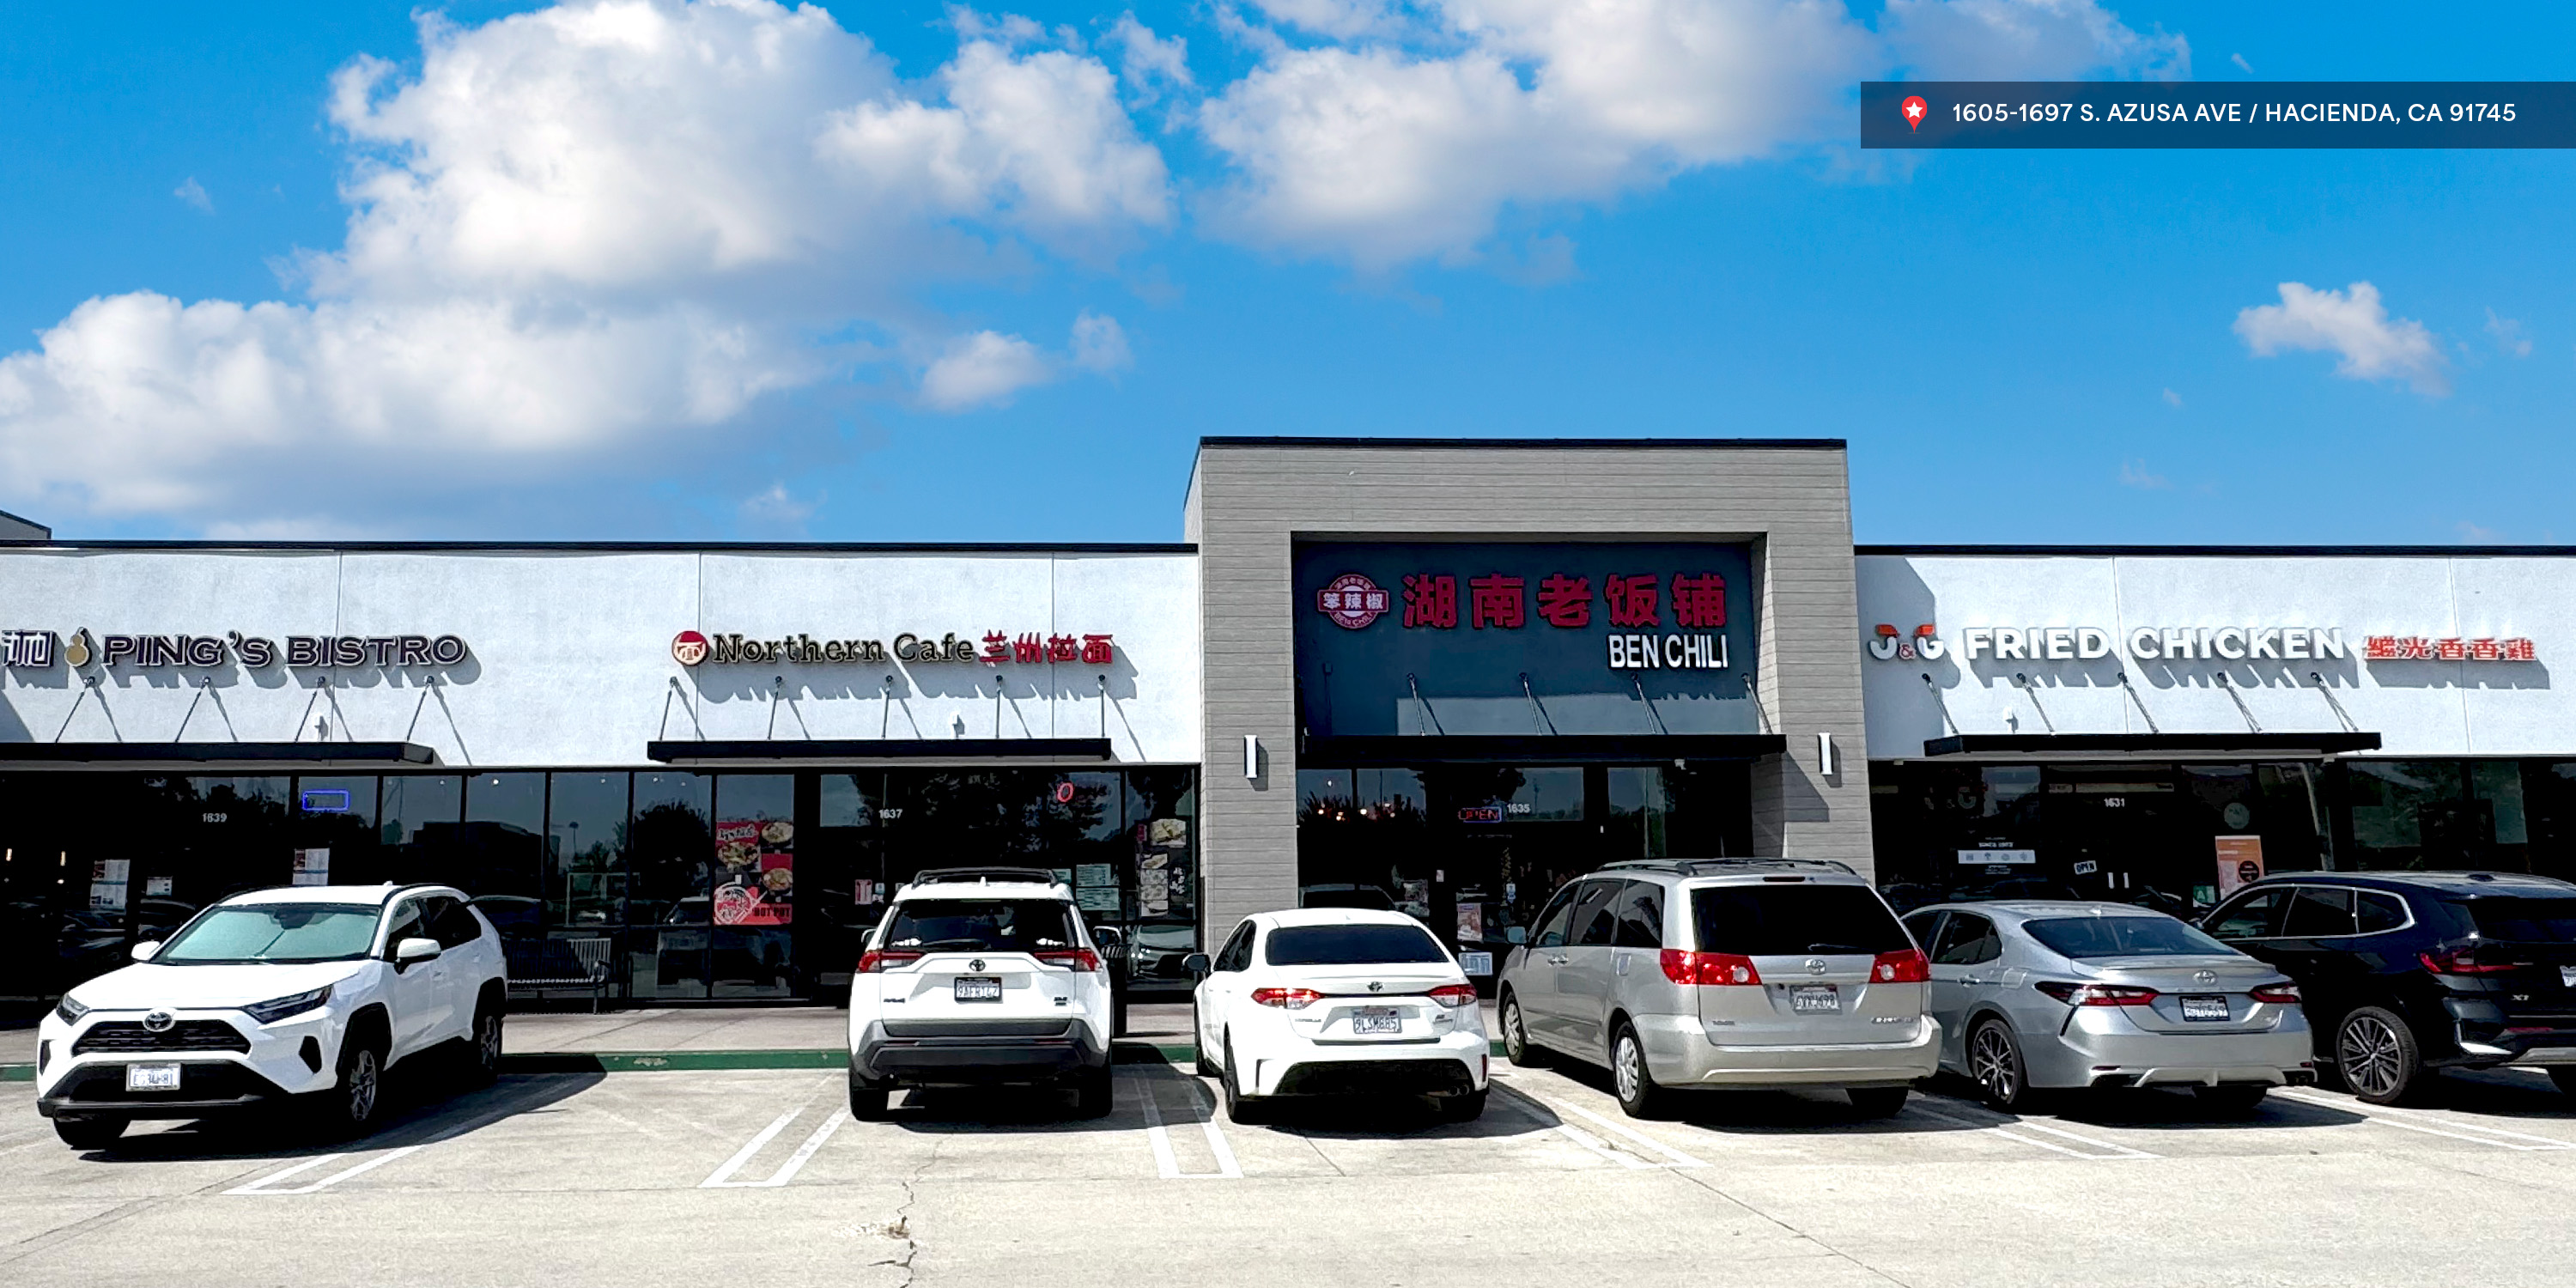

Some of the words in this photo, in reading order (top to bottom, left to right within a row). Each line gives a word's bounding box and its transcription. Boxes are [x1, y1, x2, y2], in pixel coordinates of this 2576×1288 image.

[1403, 573, 1727, 629] 湖南老饭铺
[101, 629, 272, 666] PING'S
[285, 634, 467, 666] BISTRO
[713, 633, 885, 663] Northern
[894, 632, 975, 663] Cafe
[979, 629, 1114, 664] 兰州拉面
[1608, 635, 1660, 668] BEN
[1665, 635, 1728, 668] CHILI
[1964, 627, 2111, 659] FRIED
[2129, 627, 2346, 659] CHICKEN
[202, 812, 228, 824] 1639
[878, 809, 902, 819] 1637
[1506, 803, 1531, 814] 1635
[2104, 798, 2126, 808] 1631
